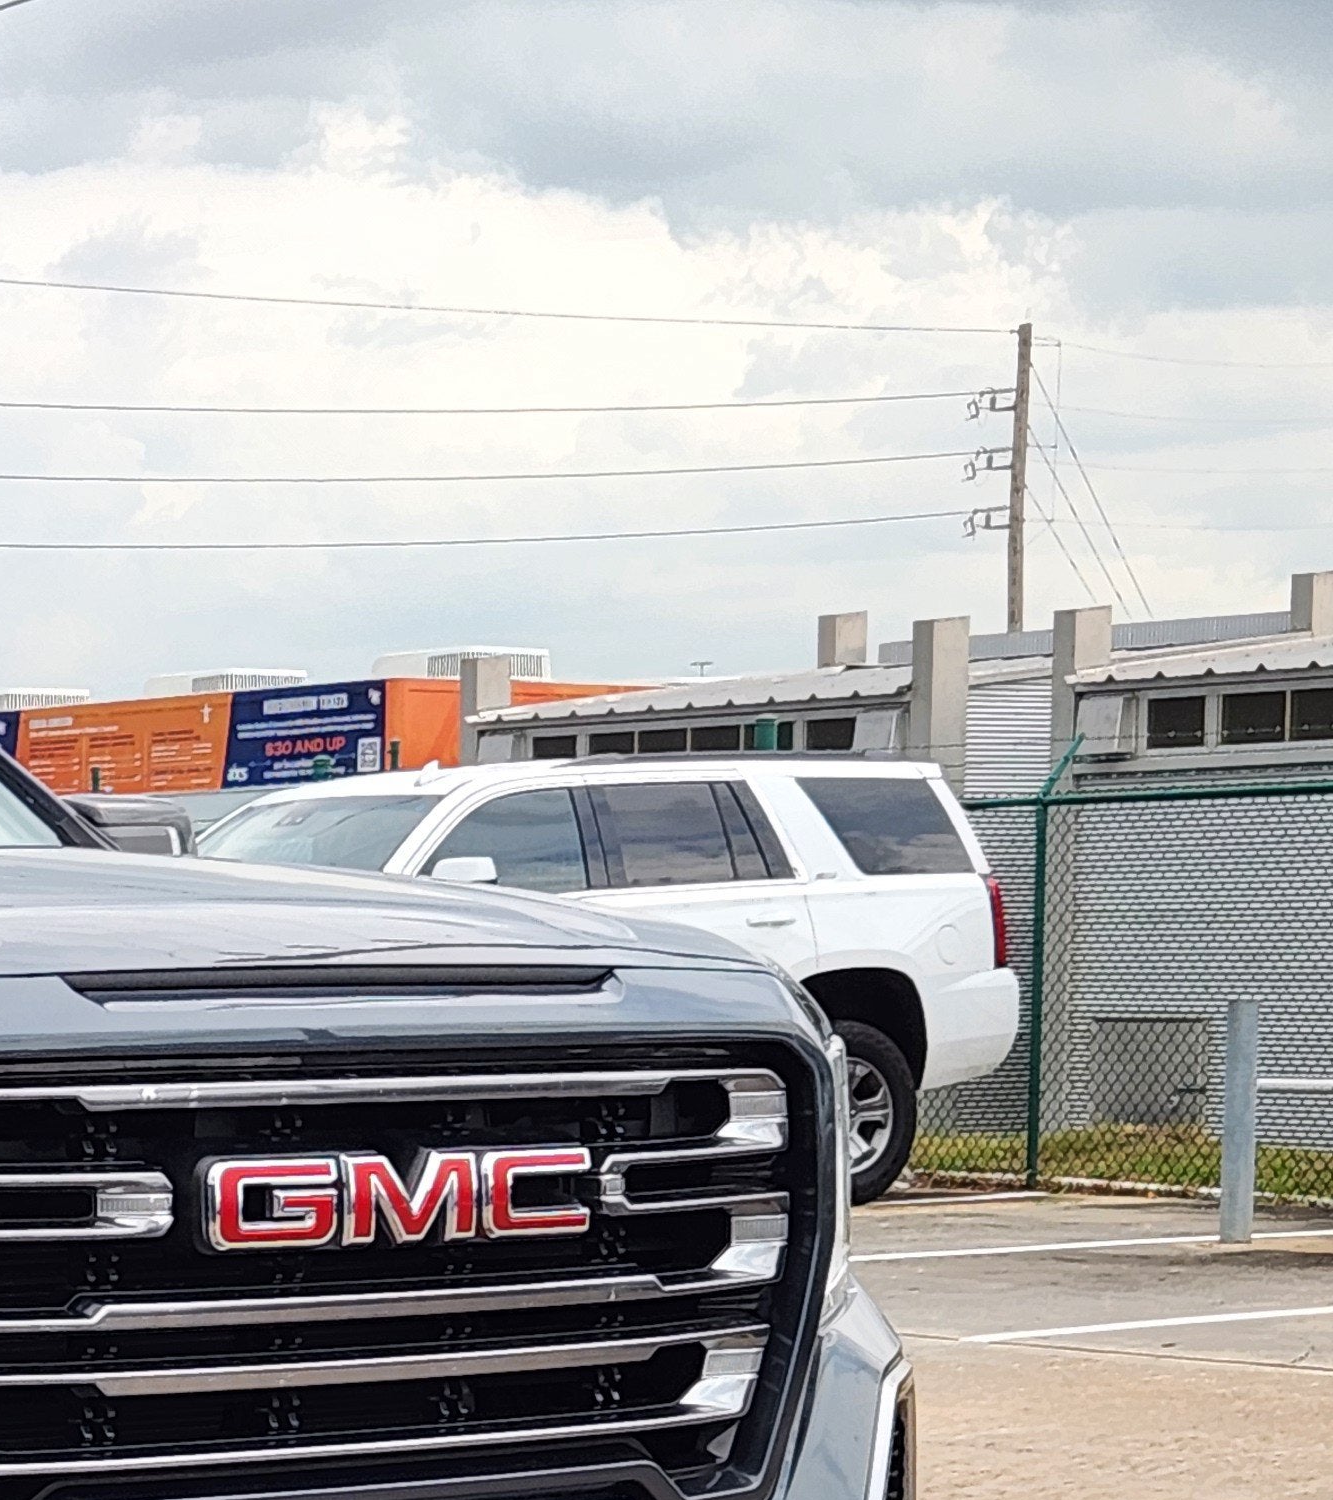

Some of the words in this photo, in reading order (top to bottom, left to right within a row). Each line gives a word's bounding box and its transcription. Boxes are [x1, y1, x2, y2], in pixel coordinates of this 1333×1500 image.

[264, 740, 293, 757] $30
[293, 738, 324, 754] AND
[326, 735, 346, 751] UP
[205, 1145, 591, 1252] GMC
